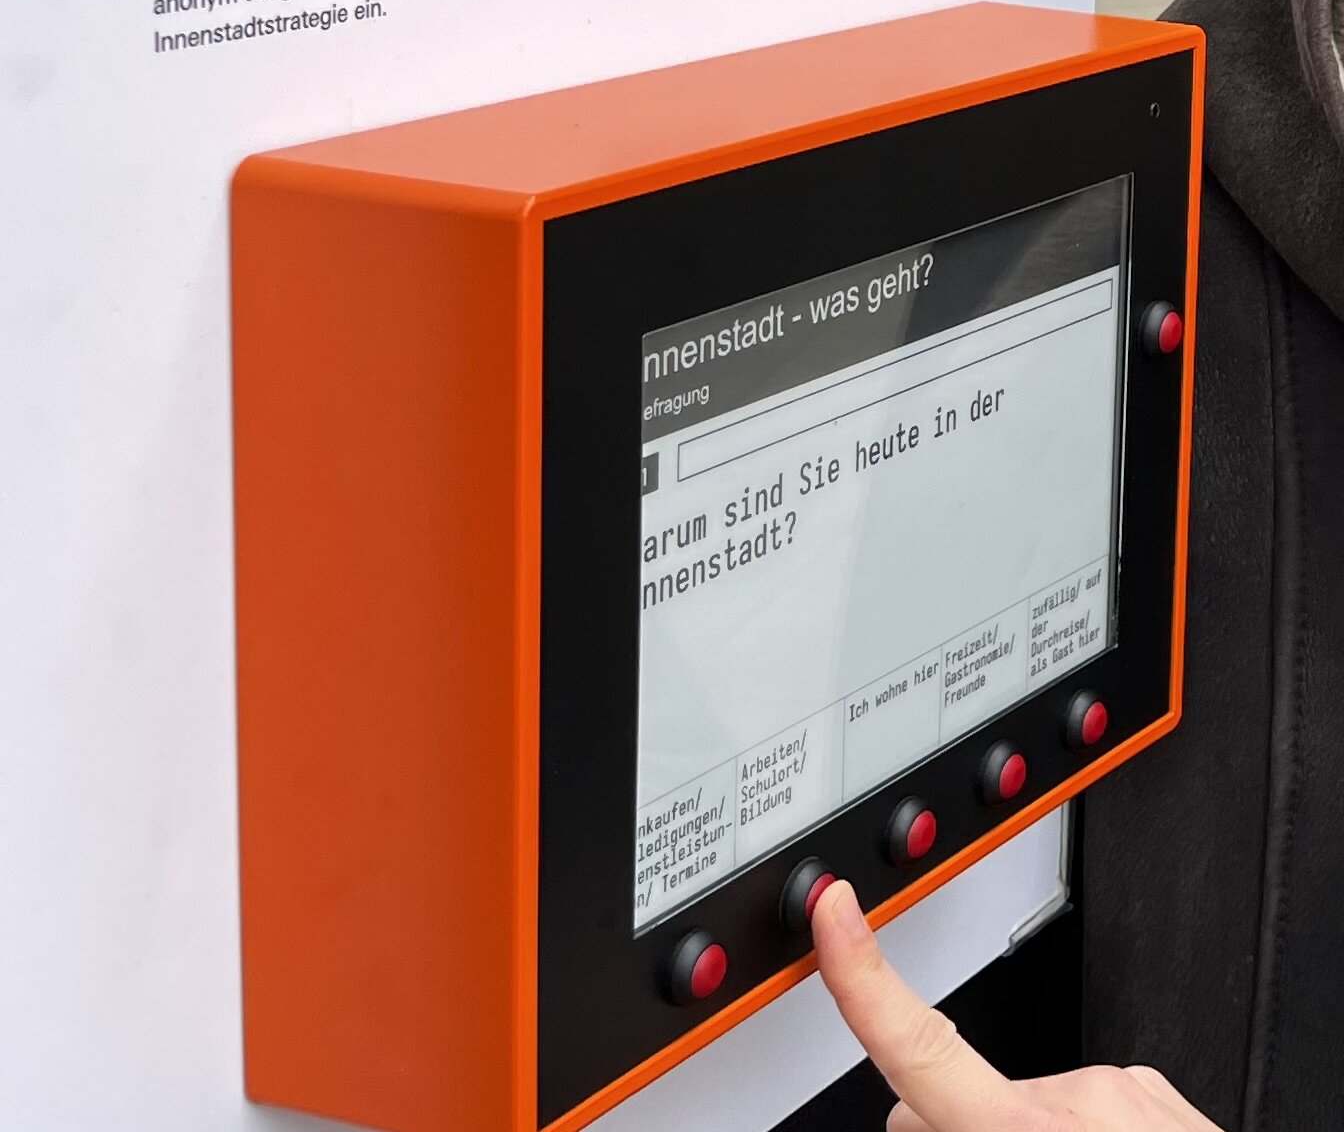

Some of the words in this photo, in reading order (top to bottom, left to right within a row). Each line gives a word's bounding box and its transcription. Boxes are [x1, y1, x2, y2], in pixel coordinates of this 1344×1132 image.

[155, 4, 348, 53] Innenstadtstrategie
[354, 0, 386, 20] ein.
[643, 305, 784, 382] nnenstadt
[810, 286, 859, 323] was
[868, 254, 933, 312] geht?
[644, 386, 709, 420] efragung
[644, 514, 706, 563] arum
[725, 472, 783, 527] sind
[800, 456, 839, 495] Sie
[856, 423, 919, 472] heute
[934, 407, 956, 438] in
[970, 389, 1004, 422] der
[643, 511, 796, 609] nnenstadt?
[1032, 578, 1081, 620] zufällig/
[1085, 568, 1102, 590] auf
[945, 623, 999, 668] Freizeit/
[1031, 609, 1090, 658] Durchreise/
[1031, 657, 1047, 676] als
[1053, 640, 1074, 663] Gast
[1079, 627, 1100, 648] hier
[1032, 620, 1048, 638] der
[944, 633, 1015, 688] Gastronomie/
[849, 698, 868, 722] Ich
[875, 679, 908, 707] wohne
[914, 662, 939, 686] hier
[944, 674, 986, 708] Freunde
[741, 728, 807, 782] Arbeiten/
[741, 750, 807, 804] Schulort/
[638, 787, 702, 840] nkaufen/
[638, 796, 725, 862] ledigungen/
[740, 786, 792, 826] Bildung
[638, 822, 732, 885] enstleistun-
[662, 851, 717, 892] Termine
